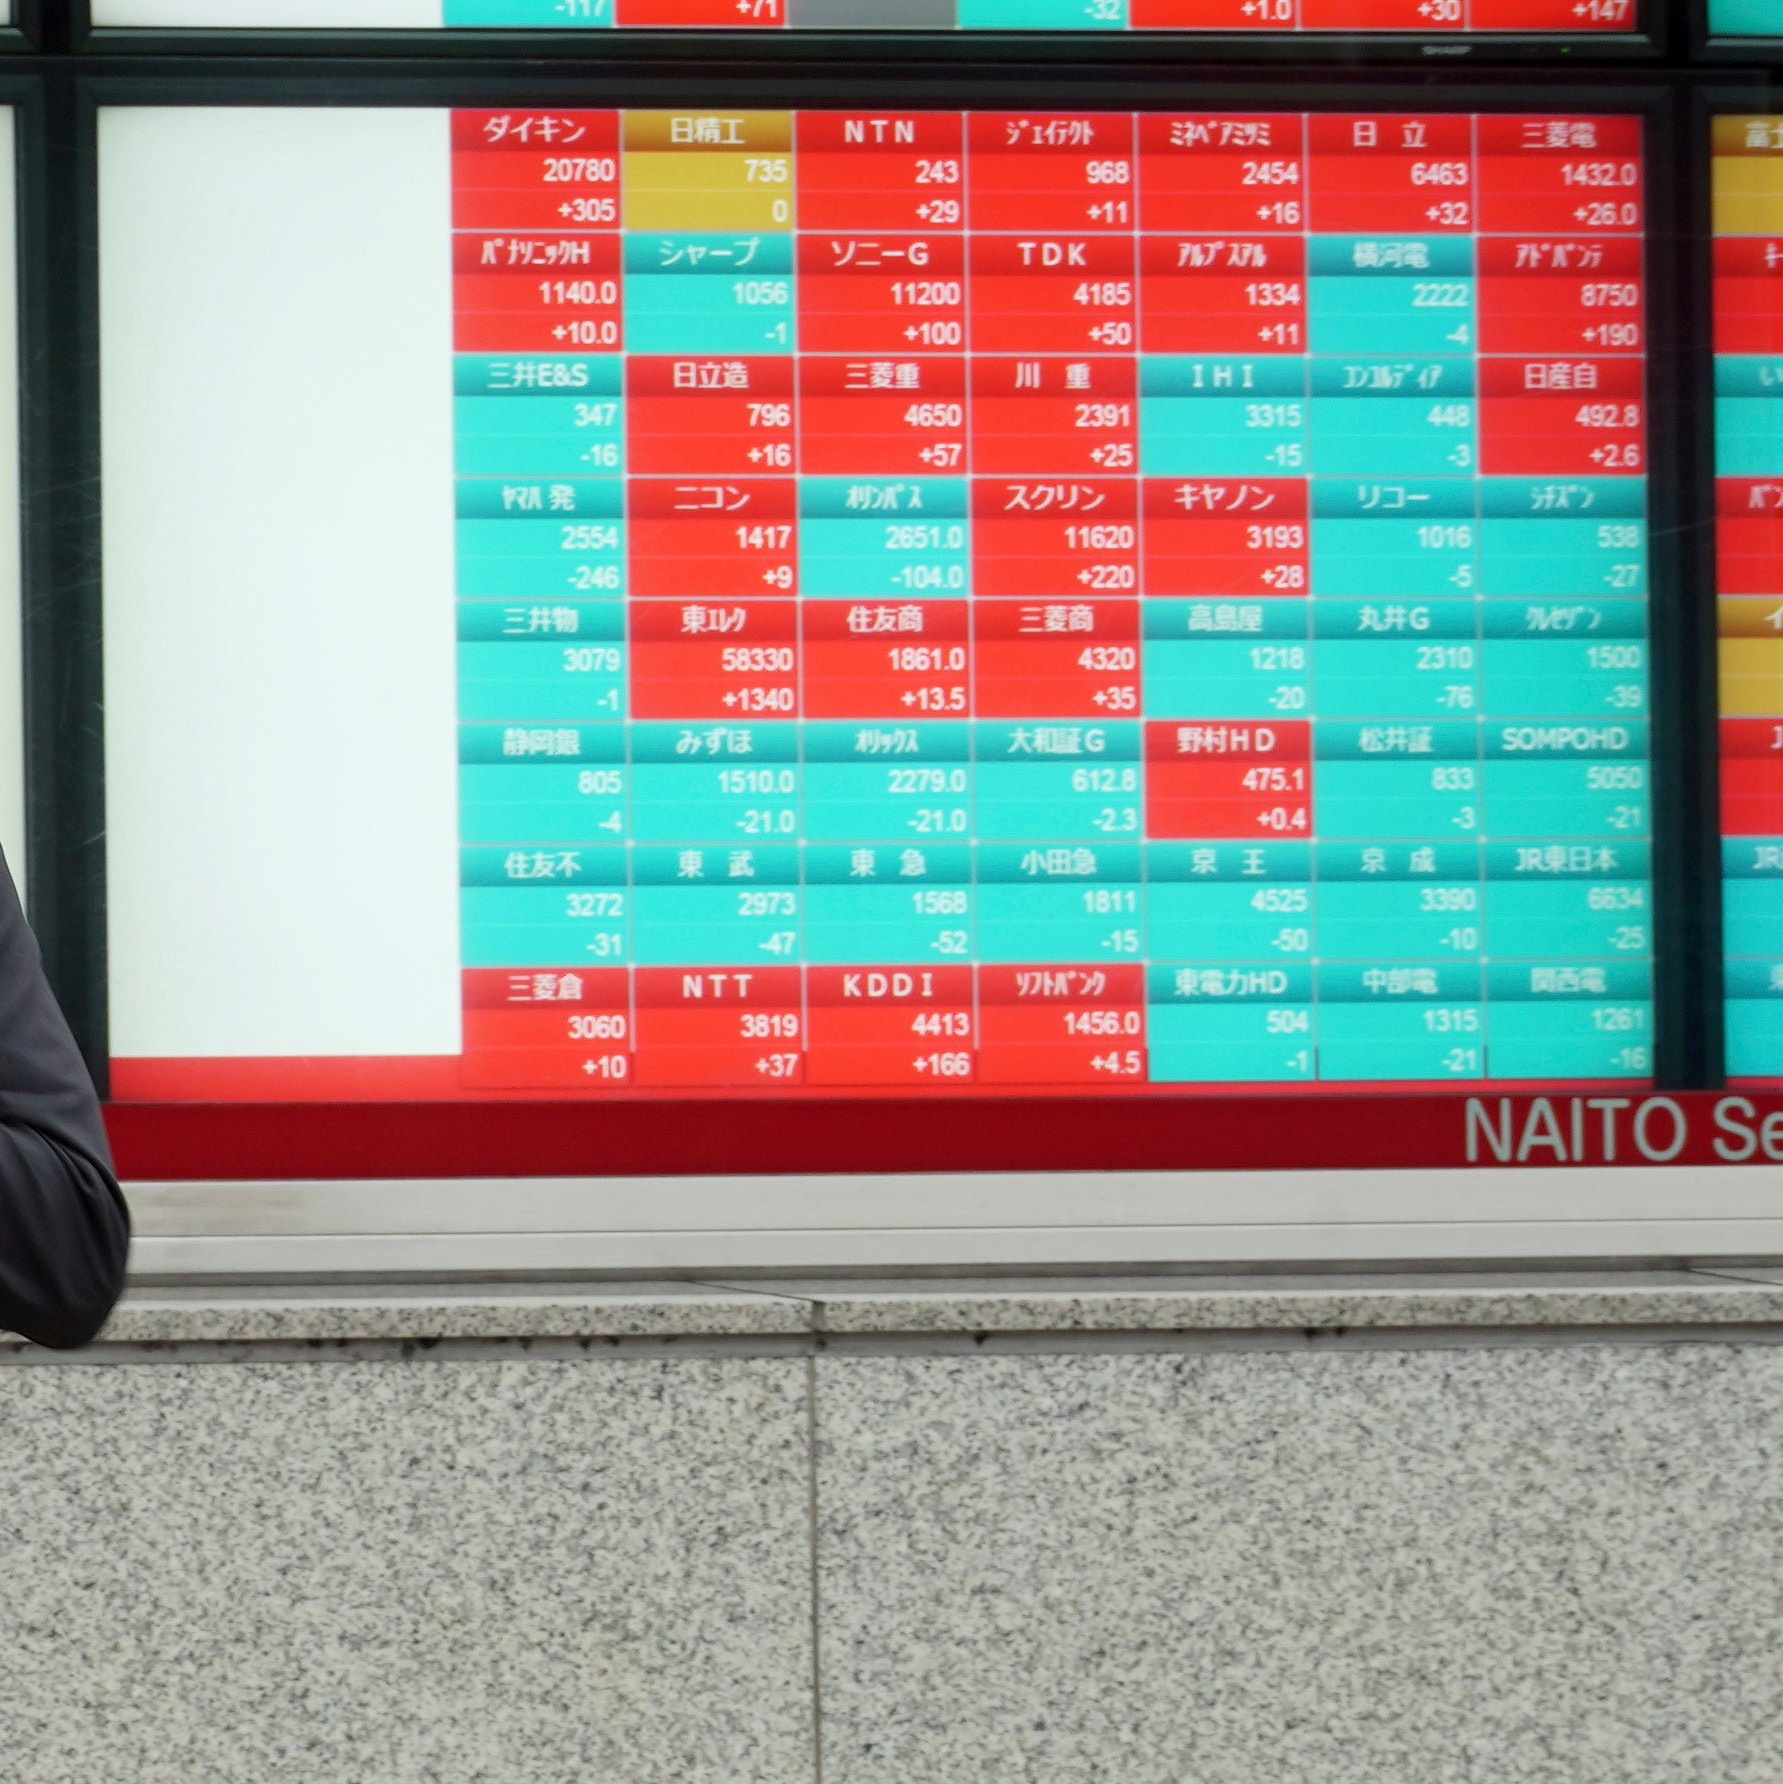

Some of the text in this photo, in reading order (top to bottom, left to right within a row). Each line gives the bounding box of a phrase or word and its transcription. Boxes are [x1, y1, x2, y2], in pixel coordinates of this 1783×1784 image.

[483, 114, 586, 143] ダイキン
[671, 116, 746, 145] 日精工
[1522, 120, 1597, 149] 三菱電
[543, 157, 616, 182] 20780
[743, 157, 789, 183] 735
[915, 159, 960, 184] 243
[1085, 160, 1131, 185] 968
[1242, 160, 1300, 186] 2454
[1410, 161, 1469, 186] 6463
[1560, 162, 1637, 187] 1432.0
[557, 197, 617, 222] +305
[915, 199, 961, 224] +29
[1086, 200, 1128, 224] +11
[1256, 200, 1302, 225] +16
[1425, 201, 1470, 226] +32
[1573, 201, 1638, 226] +26.0
[659, 236, 761, 267] シャープ
[831, 240, 929, 267] ソニーG
[539, 280, 618, 305] 1140.0
[732, 280, 791, 306] 1056
[890, 281, 962, 306] 11200
[1073, 281, 1133, 306] 4185
[1245, 282, 1302, 307] 1334
[1411, 283, 1471, 308] 2222
[1580, 282, 1638, 307] 8750
[552, 320, 618, 345] +10.0
[903, 321, 962, 346] +100
[1088, 321, 1133, 346] +50
[1257, 322, 1299, 346] +11
[1581, 322, 1639, 347] +190
[488, 361, 590, 389] 三井E&S
[673, 361, 750, 389] 日立造
[845, 361, 920, 389] 三菱重
[1524, 361, 1598, 390] 日産自
[573, 401, 619, 428] 347
[746, 402, 792, 427] 796
[903, 402, 963, 428] 4650
[1074, 402, 1131, 428] 2391
[1244, 403, 1302, 428] 3315
[1426, 402, 1473, 428] 448
[1574, 403, 1640, 428] 492.8
[580, 442, 619, 468] -16
[747, 442, 792, 468] +16
[918, 442, 963, 468] +57
[1089, 442, 1134, 468] +25
[1264, 442, 1304, 468] -15
[1589, 443, 1640, 468] +2.6
[674, 485, 751, 511] ニコン
[1004, 484, 1106, 511] スクリン
[1174, 483, 1275, 511] キヤノン
[1357, 484, 1431, 510] リコー
[560, 524, 620, 550] 2554
[736, 524, 793, 549] 1417
[884, 524, 965, 550] 2651.0
[1064, 524, 1135, 549] 11620
[1246, 524, 1305, 549] 3193
[1416, 524, 1474, 549] 1016
[1596, 524, 1641, 549] 538
[567, 564, 620, 590] -246
[890, 563, 965, 589] -104.0
[1077, 564, 1136, 590] +220
[1260, 564, 1305, 589] +28
[1603, 563, 1641, 589] -27
[502, 605, 579, 634] 三井物
[846, 604, 924, 634] 住友商
[1019, 603, 1094, 633] 三菱商
[1187, 603, 1263, 633] 高島屋
[1357, 604, 1431, 632] 丸井G
[562, 646, 622, 673] 3079
[722, 646, 795, 672] 58330
[888, 646, 966, 671] 1861.0
[1077, 646, 1137, 671] 4320
[1249, 645, 1307, 671] 1218
[1416, 645, 1475, 671] 2310
[1586, 644, 1643, 670] 1500
[722, 687, 795, 712] +1340
[900, 686, 967, 711] +13.5
[1092, 685, 1137, 711] +35
[1267, 685, 1307, 711] -20
[1436, 684, 1476, 709] -76
[1604, 684, 1645, 709] -39
[675, 726, 753, 756] みずほ
[1007, 726, 1106, 755] 大和証G
[1177, 726, 1276, 754] 野村HD
[1502, 726, 1628, 752] SOMPOHD
[577, 769, 624, 795] 805
[717, 768, 796, 795] 1510.0
[887, 768, 968, 794] 2279.0
[1071, 767, 1140, 793] 612.8
[1242, 766, 1304, 792] 475.1
[1431, 766, 1477, 791] 833
[1586, 765, 1644, 790] 5050
[735, 808, 798, 835] -21.0
[906, 807, 968, 833] -21.0
[1091, 806, 1141, 833] -2.3
[1256, 806, 1308, 831] +0.4
[1605, 804, 1642, 830] -21
[503, 851, 582, 879] 住友不
[1020, 846, 1098, 876] 小田急
[1514, 844, 1616, 874] JR東日本
[565, 891, 624, 918] 3272
[737, 890, 798, 917] 2973
[911, 889, 969, 915] 1568
[1082, 888, 1136, 914] 1811
[1250, 887, 1309, 913] 4525
[1420, 886, 1478, 912] 3390
[1586, 886, 1645, 911] 6634
[585, 931, 622, 957] -31
[758, 930, 797, 955] -47
[930, 929, 969, 955] -52
[1100, 928, 1140, 954] -15
[1270, 927, 1310, 952] -50
[1439, 926, 1479, 951] -10
[1607, 925, 1646, 950] -25
[507, 972, 584, 1002] 三菱倉
[1174, 967, 1288, 997] 東電力HD
[568, 1014, 627, 1040] 3060
[740, 1013, 799, 1038] 3819
[911, 1011, 971, 1037] 4413
[1063, 1010, 1141, 1036] 1456.0
[1266, 1009, 1310, 1034] 504
[1422, 1007, 1480, 1033] 1315
[1591, 1007, 1644, 1032] 1261
[582, 1054, 628, 1079] +10
[755, 1052, 799, 1078] +37
[912, 1051, 971, 1077] +166
[1090, 1049, 1142, 1075] +4.5
[1441, 1047, 1477, 1073] -21
[1610, 1046, 1649, 1070] -16
[1464, 1096, 1687, 1162] NAITO
